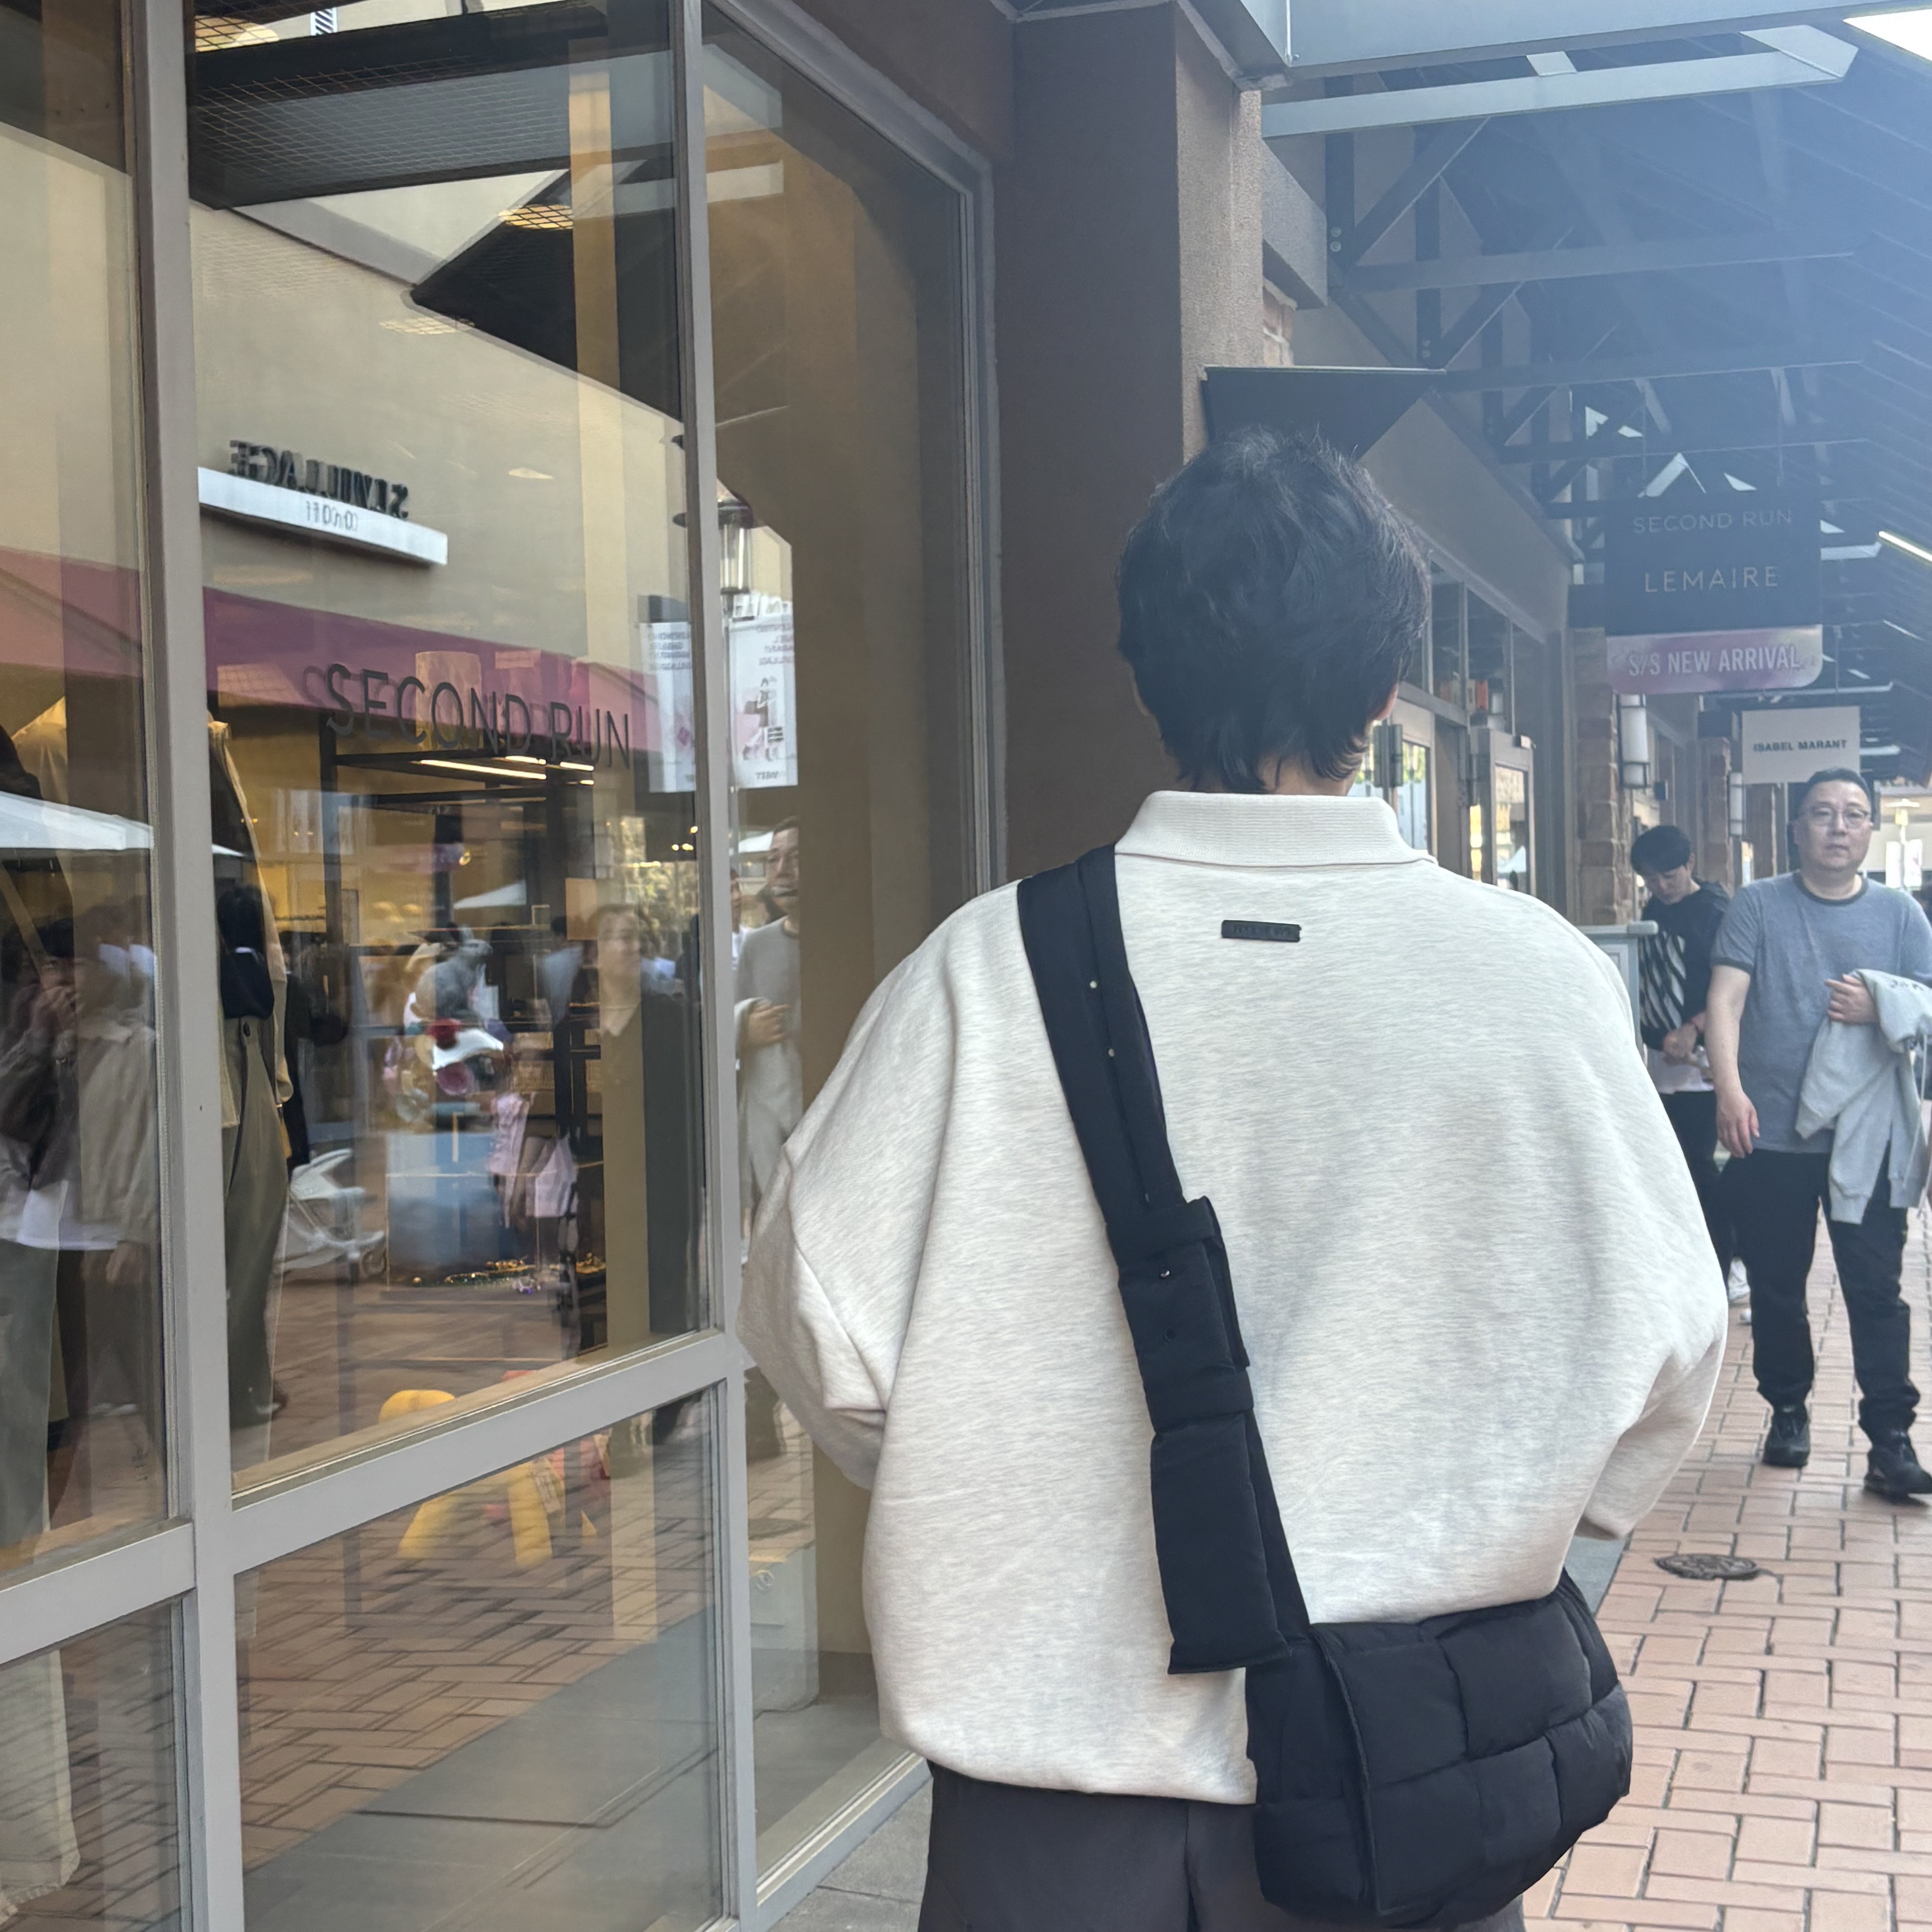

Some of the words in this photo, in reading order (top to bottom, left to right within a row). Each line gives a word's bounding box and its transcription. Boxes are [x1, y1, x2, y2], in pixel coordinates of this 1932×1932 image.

[1633, 512, 1733, 534] SECOND
[1743, 509, 1792, 527] RUN
[1645, 566, 1778, 593] LEMAIRE
[1628, 653, 1661, 676] S/S
[1669, 650, 1711, 674] NEW
[1718, 645, 1801, 672] ARRIVAL
[326, 663, 531, 755] SECOND
[549, 701, 629, 770] RUN
[1753, 741, 1794, 752] ISABEL
[1798, 739, 1848, 750] MARANT
